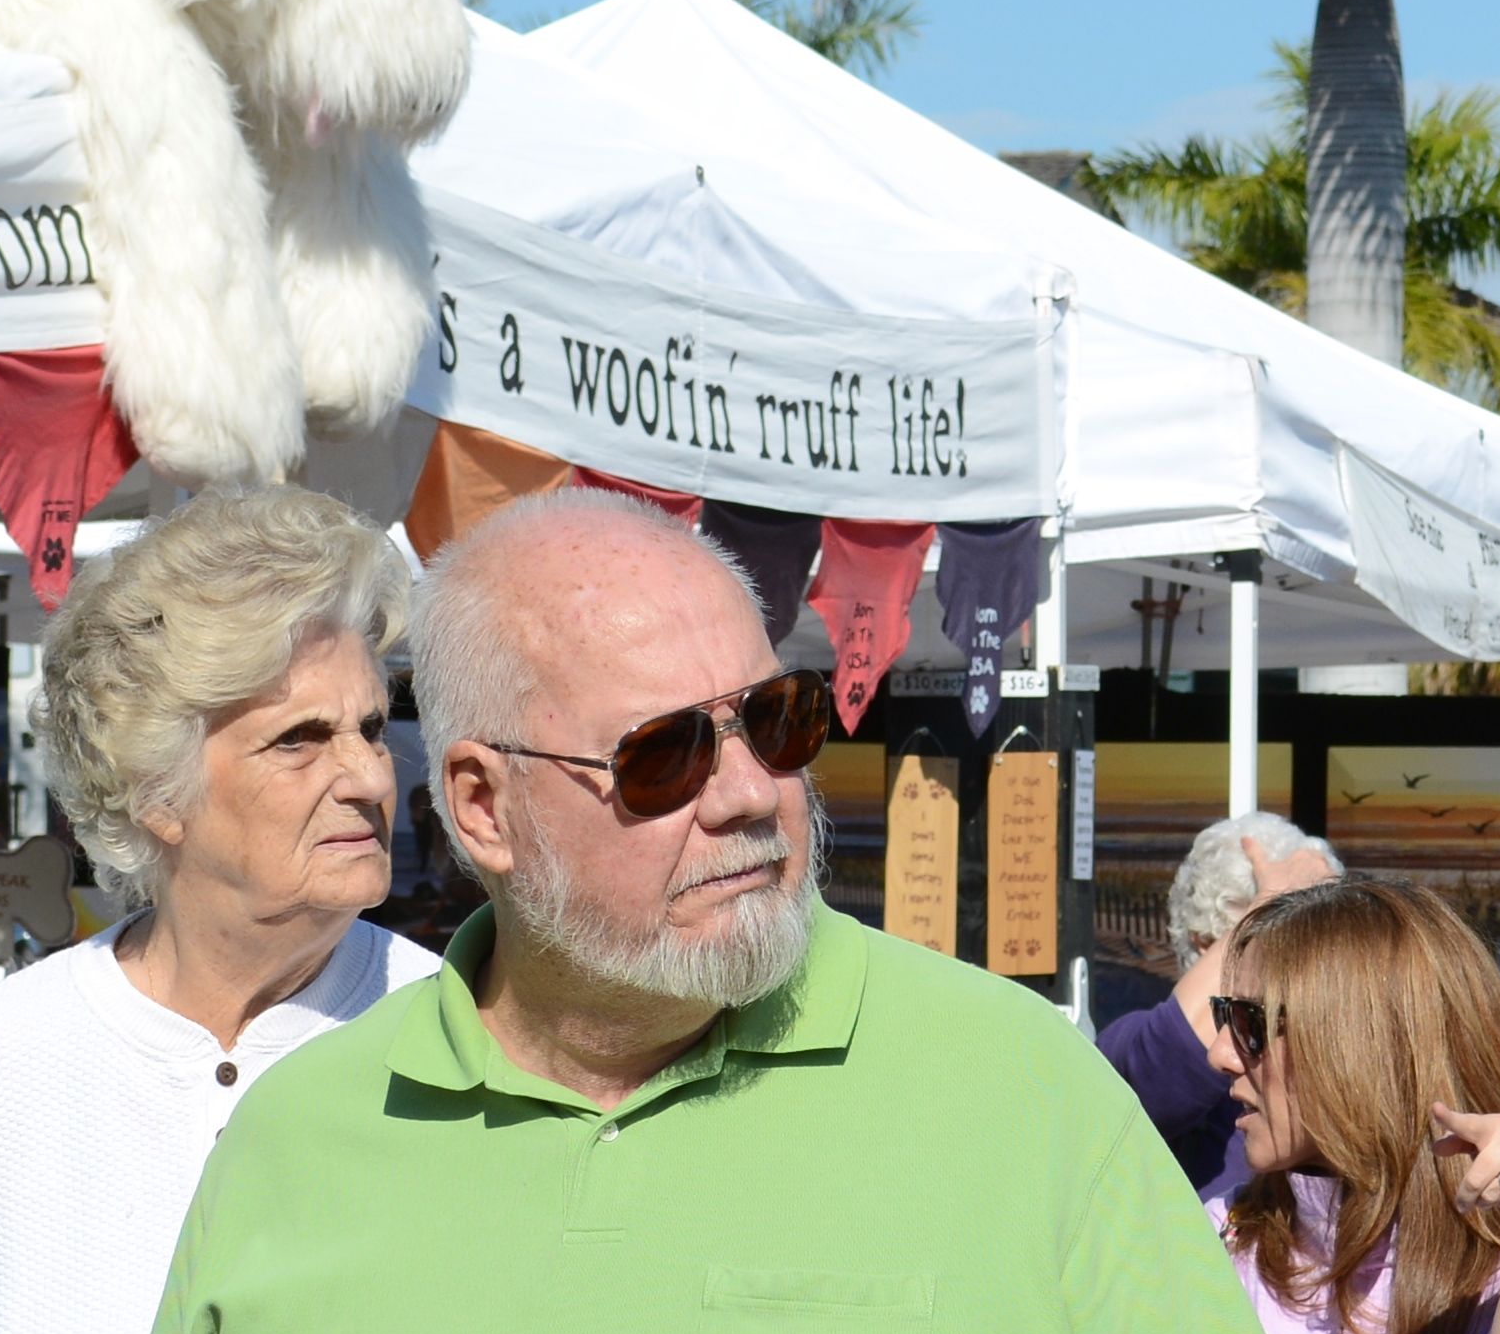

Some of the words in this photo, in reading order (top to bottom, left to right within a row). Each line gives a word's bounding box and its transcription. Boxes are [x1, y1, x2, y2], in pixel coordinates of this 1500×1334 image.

[500, 313, 524, 395] a
[756, 370, 860, 471] rruff
[888, 373, 967, 478] life!
[903, 676, 929, 691] $10
[1010, 676, 1035, 691] $16
